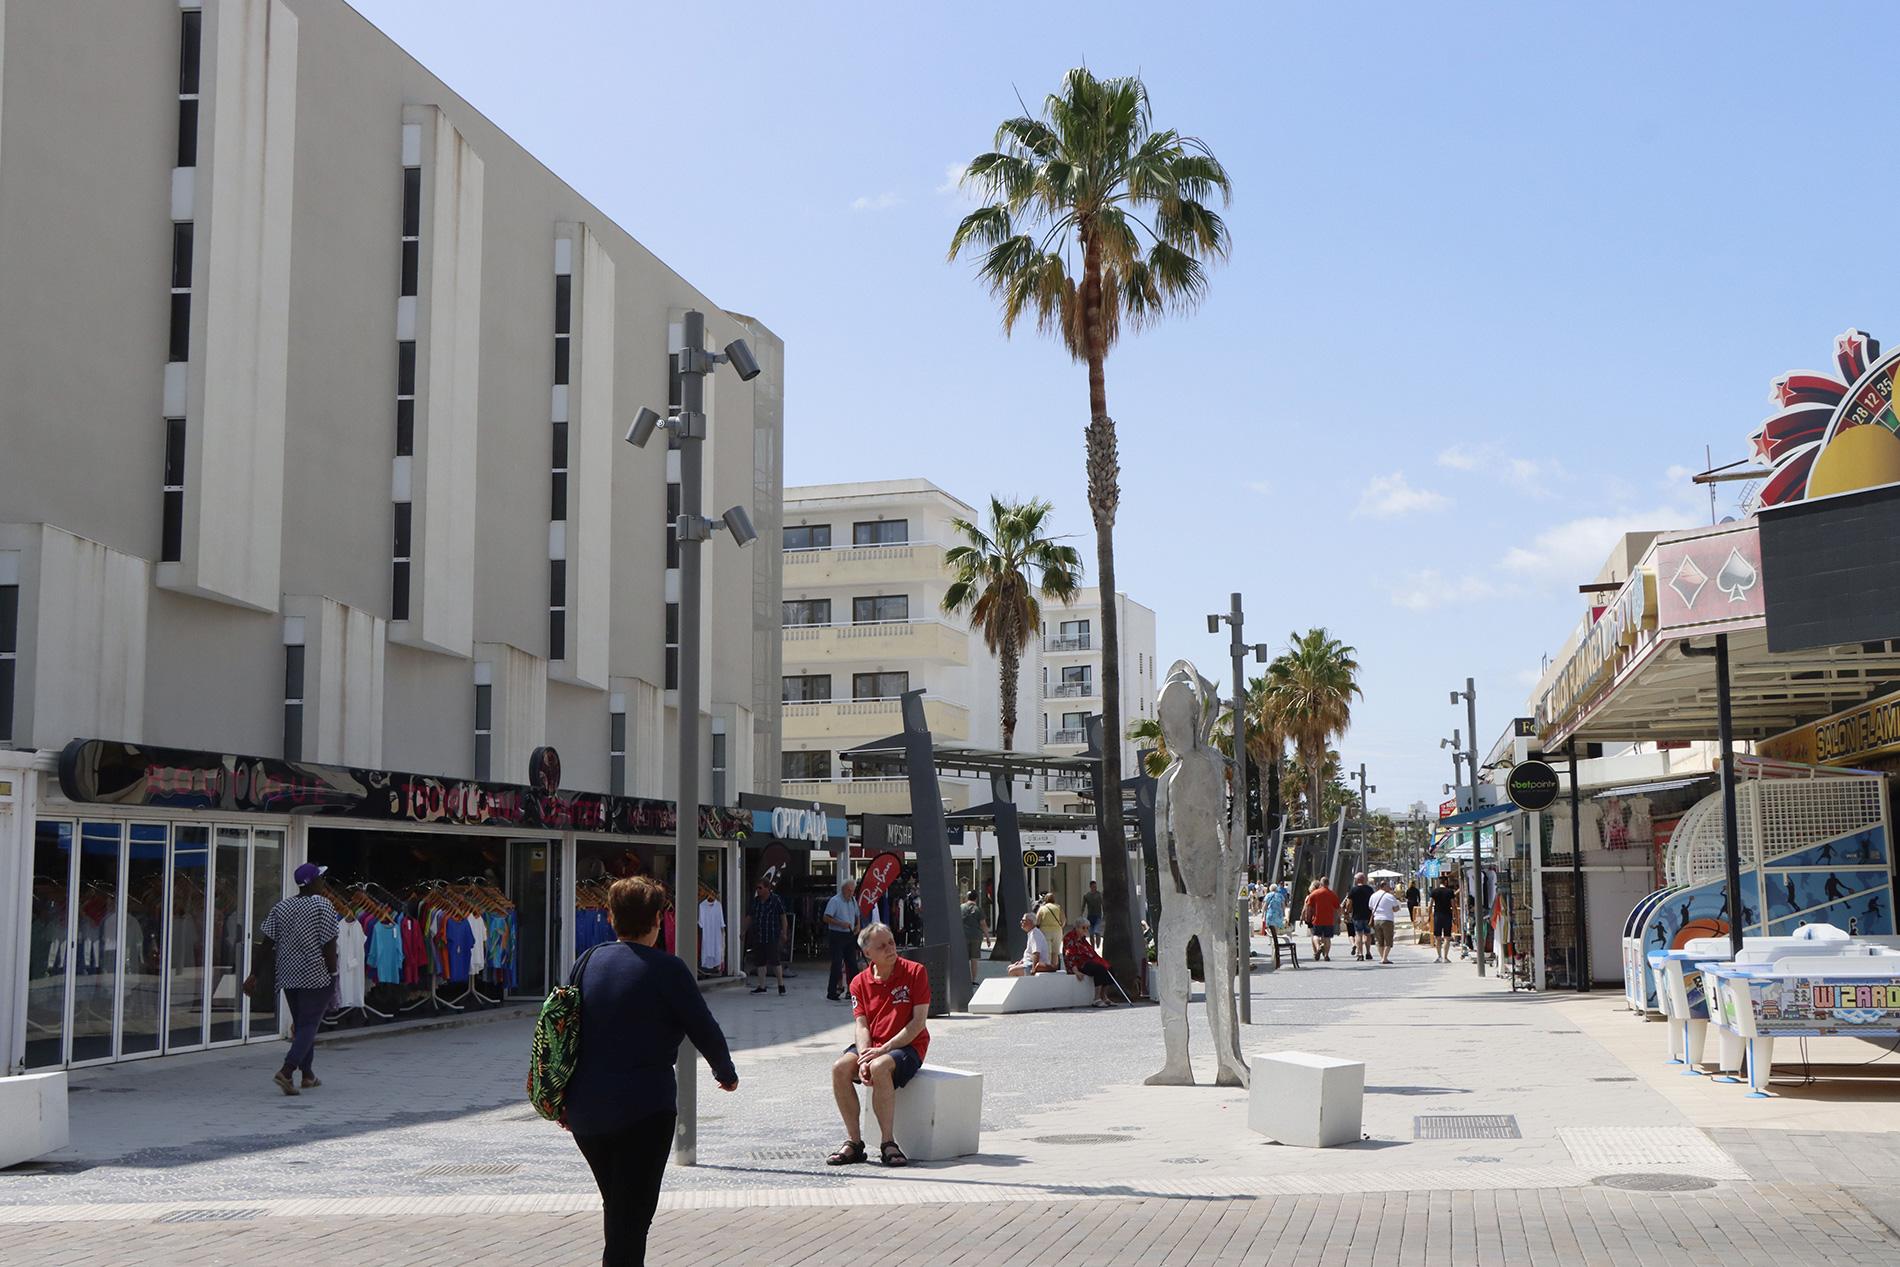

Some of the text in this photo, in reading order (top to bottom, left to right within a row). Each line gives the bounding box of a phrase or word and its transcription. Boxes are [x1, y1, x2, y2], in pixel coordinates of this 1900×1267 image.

[1852, 378, 1893, 424] 28 12 35
[1815, 715, 1857, 763] SALON
[145, 763, 327, 804] BOUTIQUE
[1515, 780, 1552, 789] betpoint
[859, 862, 893, 905] Ray-Ban
[1813, 984, 1900, 1008] WIZARD
